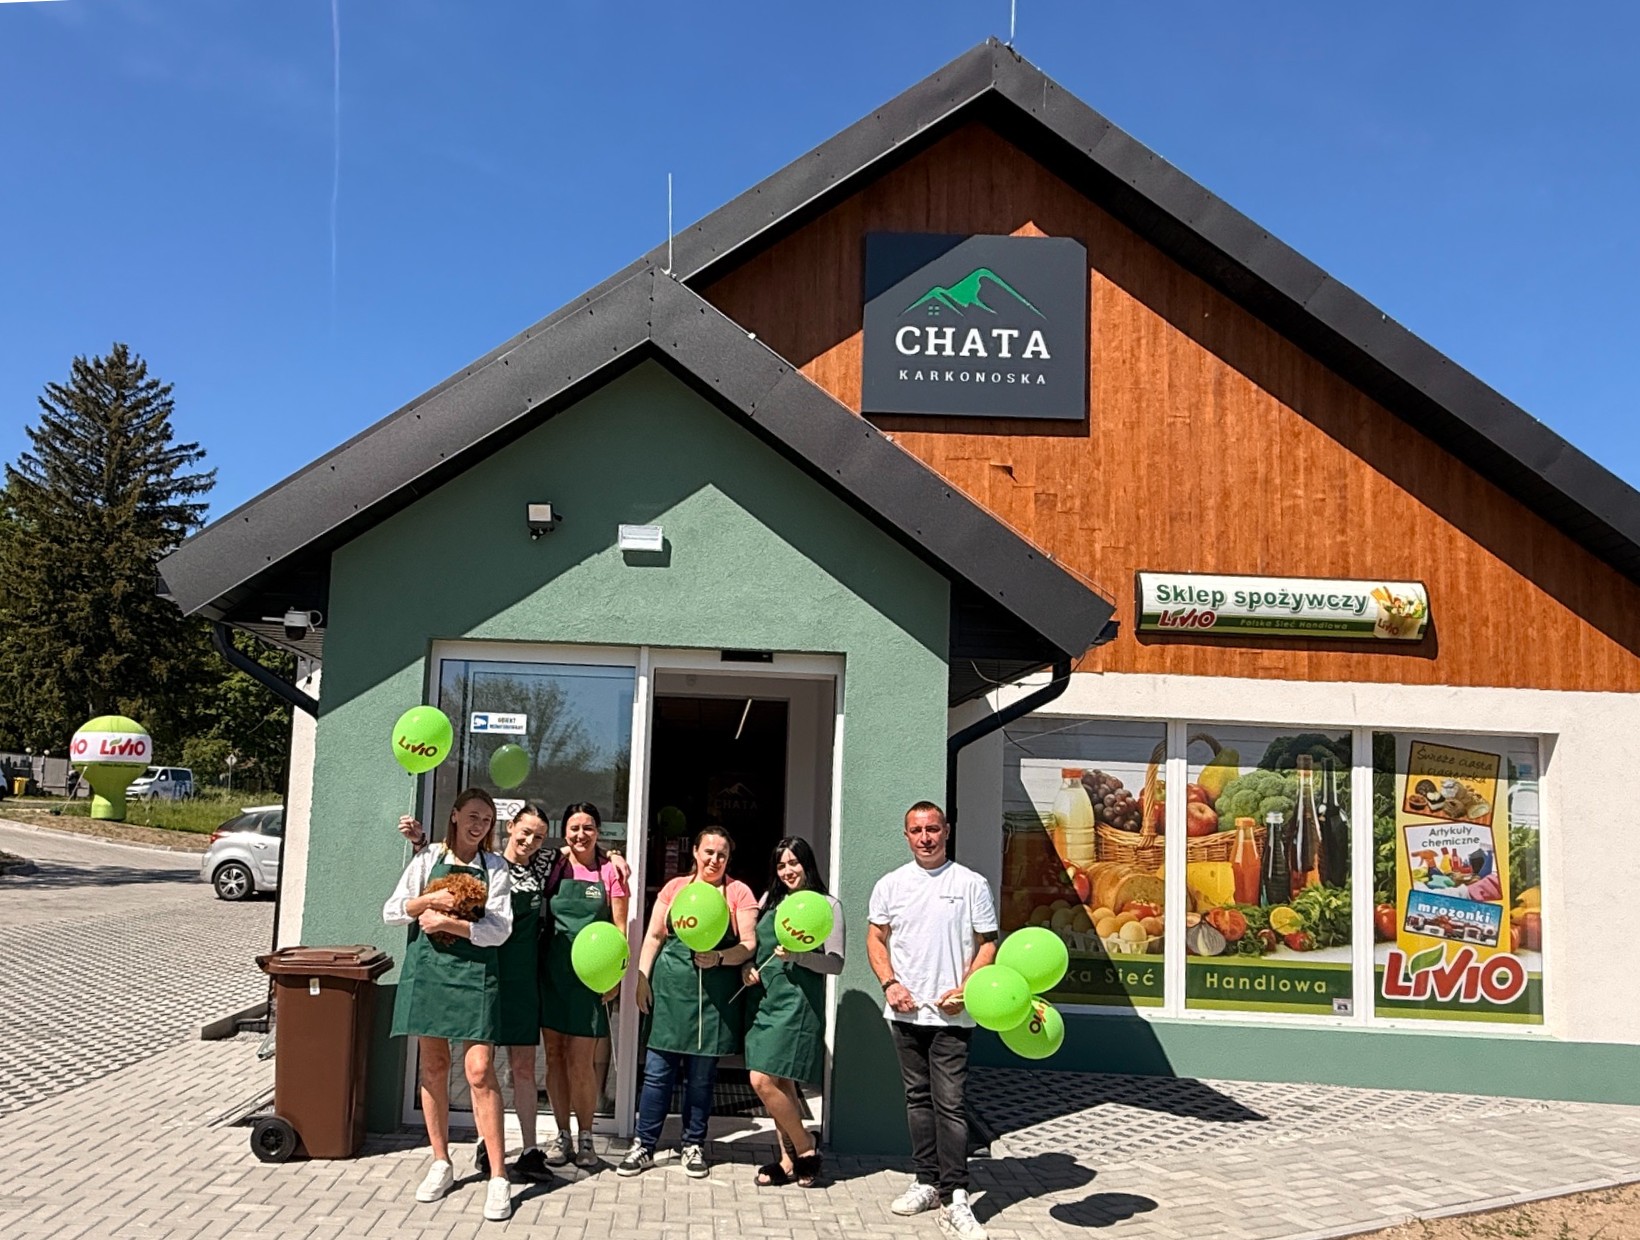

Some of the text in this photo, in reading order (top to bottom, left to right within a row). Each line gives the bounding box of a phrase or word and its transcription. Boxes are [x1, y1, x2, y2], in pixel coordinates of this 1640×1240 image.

[895, 326, 1051, 359] CHATA
[899, 370, 1046, 385] KARKONOSKA
[1156, 584, 1368, 613] Sklep spożywczy
[1429, 825, 1473, 837] Artykuły
[1421, 836, 1480, 848] chemiczne
[1417, 903, 1491, 923] mrożonki
[1105, 968, 1155, 986] Sieć
[1206, 972, 1328, 993] Handlowa
